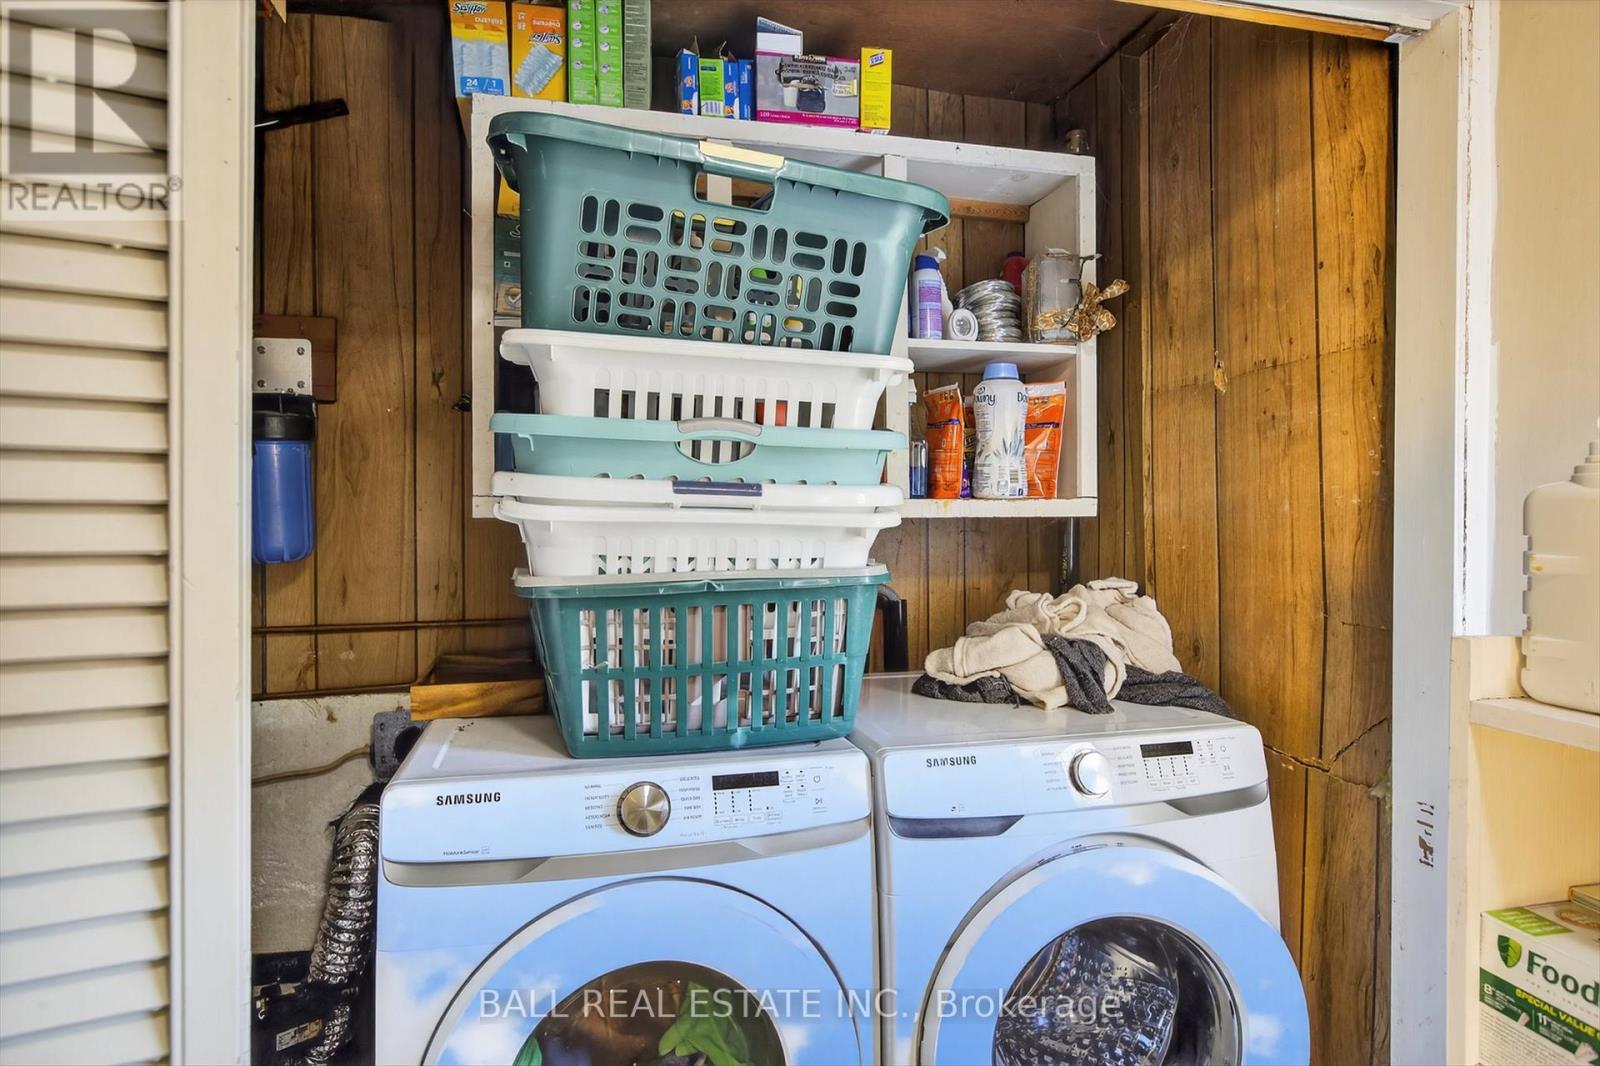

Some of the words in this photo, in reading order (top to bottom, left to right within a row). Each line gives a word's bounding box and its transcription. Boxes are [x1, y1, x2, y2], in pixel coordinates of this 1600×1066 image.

[926, 755, 977, 768] SAMSUNG
[436, 791, 502, 806] SAMSUNG
[1526, 949, 1600, 1008] Food
[1515, 988, 1558, 1017] SPECIAL
[1558, 1010, 1597, 1038] VALUE
